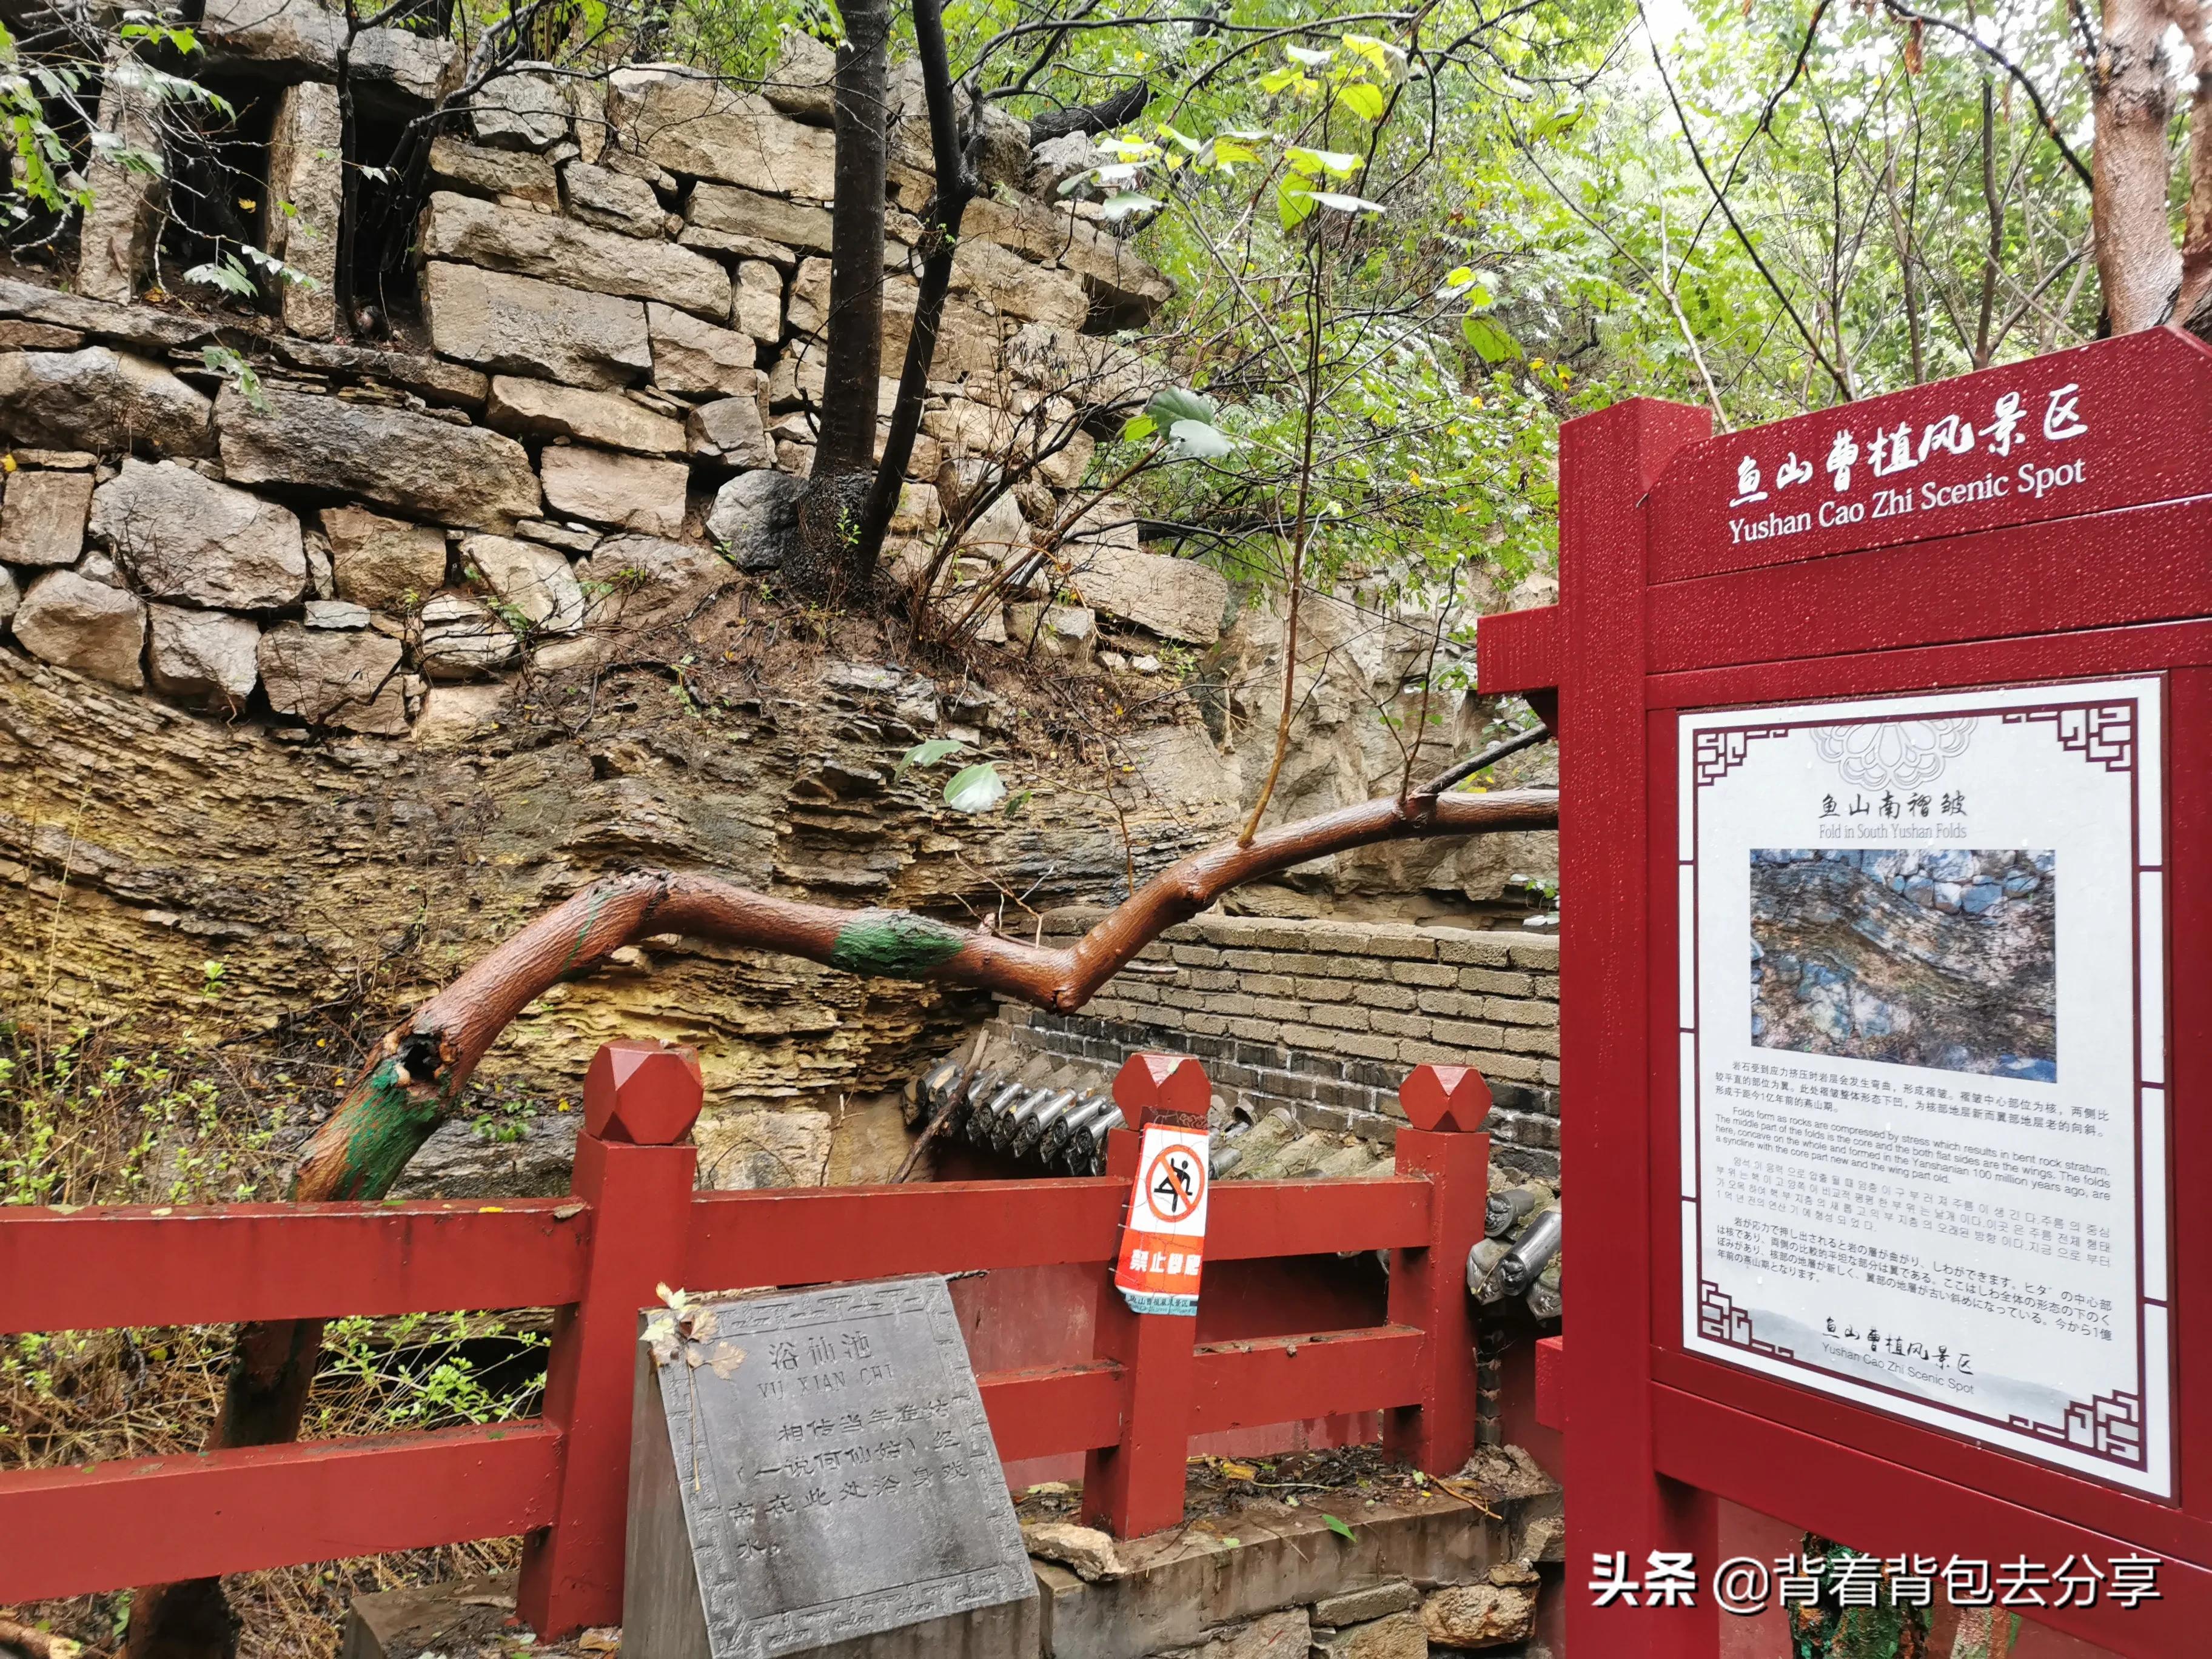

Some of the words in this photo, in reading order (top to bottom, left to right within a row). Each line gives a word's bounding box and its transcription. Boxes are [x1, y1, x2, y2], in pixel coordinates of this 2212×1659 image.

[1729, 383, 2088, 508] 鱼山曹植风景区
[1729, 512, 1812, 544] Yushan
[1819, 501, 1865, 528] Cao
[1872, 488, 1914, 518] Zhi
[1921, 473, 2009, 510] Scenic
[2017, 458, 2086, 498] Spot
[1818, 789, 1968, 819] 鱼山南褶皱
[1819, 824, 1841, 839] Fold
[1845, 825, 1854, 839] in
[1857, 823, 1888, 839] South
[1891, 823, 1932, 839] Yushan
[1936, 822, 1967, 839] Folds
[1715, 1113, 1731, 1124] The
[1732, 1118, 1758, 1128] middle
[1761, 1122, 1777, 1131] part
[1778, 1125, 1787, 1133] of
[1788, 1126, 1802, 1136] the
[1804, 1128, 1825, 1139] folds
[1827, 1131, 1834, 1141] is
[1836, 1134, 1851, 1144] the
[1852, 1138, 1872, 1147] core
[1874, 1142, 1893, 1151] and
[1894, 1144, 1910, 1154] the
[1912, 1146, 1934, 1158] both
[1936, 1150, 1951, 1161] flat
[1953, 1154, 1980, 1166] sides
[1982, 1160, 2000, 1169] are
[2002, 1162, 2019, 1173] the
[2021, 1166, 2056, 1179] wings.
[2058, 1170, 2080, 1183] The
[2082, 1175, 2111, 1188] folds
[1715, 1124, 1735, 1136] here,
[1737, 1129, 1771, 1141] concave
[1773, 1135, 1783, 1144] on
[1786, 1136, 1800, 1145] the
[1801, 1139, 1827, 1151] whole
[1829, 1144, 1846, 1154] and
[1848, 1146, 1880, 1160] formed
[1883, 1152, 1892, 1162] in
[1894, 1155, 1909, 1165] the
[1911, 1157, 1969, 1175] Yanshanian
[1972, 1168, 1992, 1179] 100
[1994, 1173, 2028, 1186] million
[2031, 1178, 2061, 1191] years
[2063, 1185, 2088, 1198] ago,
[2091, 1190, 2111, 1201] are
[1722, 1136, 1755, 1148] syncline
[1756, 1142, 1773, 1151] with
[1775, 1144, 1788, 1154] the
[1789, 1148, 1809, 1158] core
[1811, 1152, 1828, 1161] part
[1830, 1156, 1849, 1165] new
[1851, 1159, 1868, 1168] and
[1870, 1161, 1885, 1171] the
[1887, 1165, 1909, 1178] wing
[1911, 1170, 1931, 1180] part
[1932, 1173, 1951, 1184] old.
[1732, 1106, 1754, 1121] Folds
[1756, 1110, 1775, 1121] form
[1777, 1115, 1787, 1126] as
[1789, 1117, 1812, 1129] rocks
[1814, 1121, 1828, 1133] are
[1829, 1124, 1887, 1139] compressed
[1887, 1130, 1899, 1143] by
[1901, 1135, 1930, 1146] stress
[1931, 1139, 1961, 1151] which
[1963, 1145, 1997, 1158] results
[2000, 1149, 2009, 1159] in
[2012, 1151, 2036, 1164] bent
[2038, 1158, 2062, 1168] rock
[2065, 1161, 2110, 1176] stratum.
[769, 1330, 872, 1370] 浴仙池
[1822, 1316, 1974, 1375] 鱼山曹植风景区
[1822, 1342, 1860, 1362] Yushan
[1863, 1353, 1884, 1369] Cao
[1888, 1360, 1904, 1375] Zhi
[1908, 1367, 1944, 1386] Scenic
[1948, 1378, 1974, 1395] Spot
[797, 1370, 846, 1396] XIAN
[860, 1364, 894, 1386] CHI
